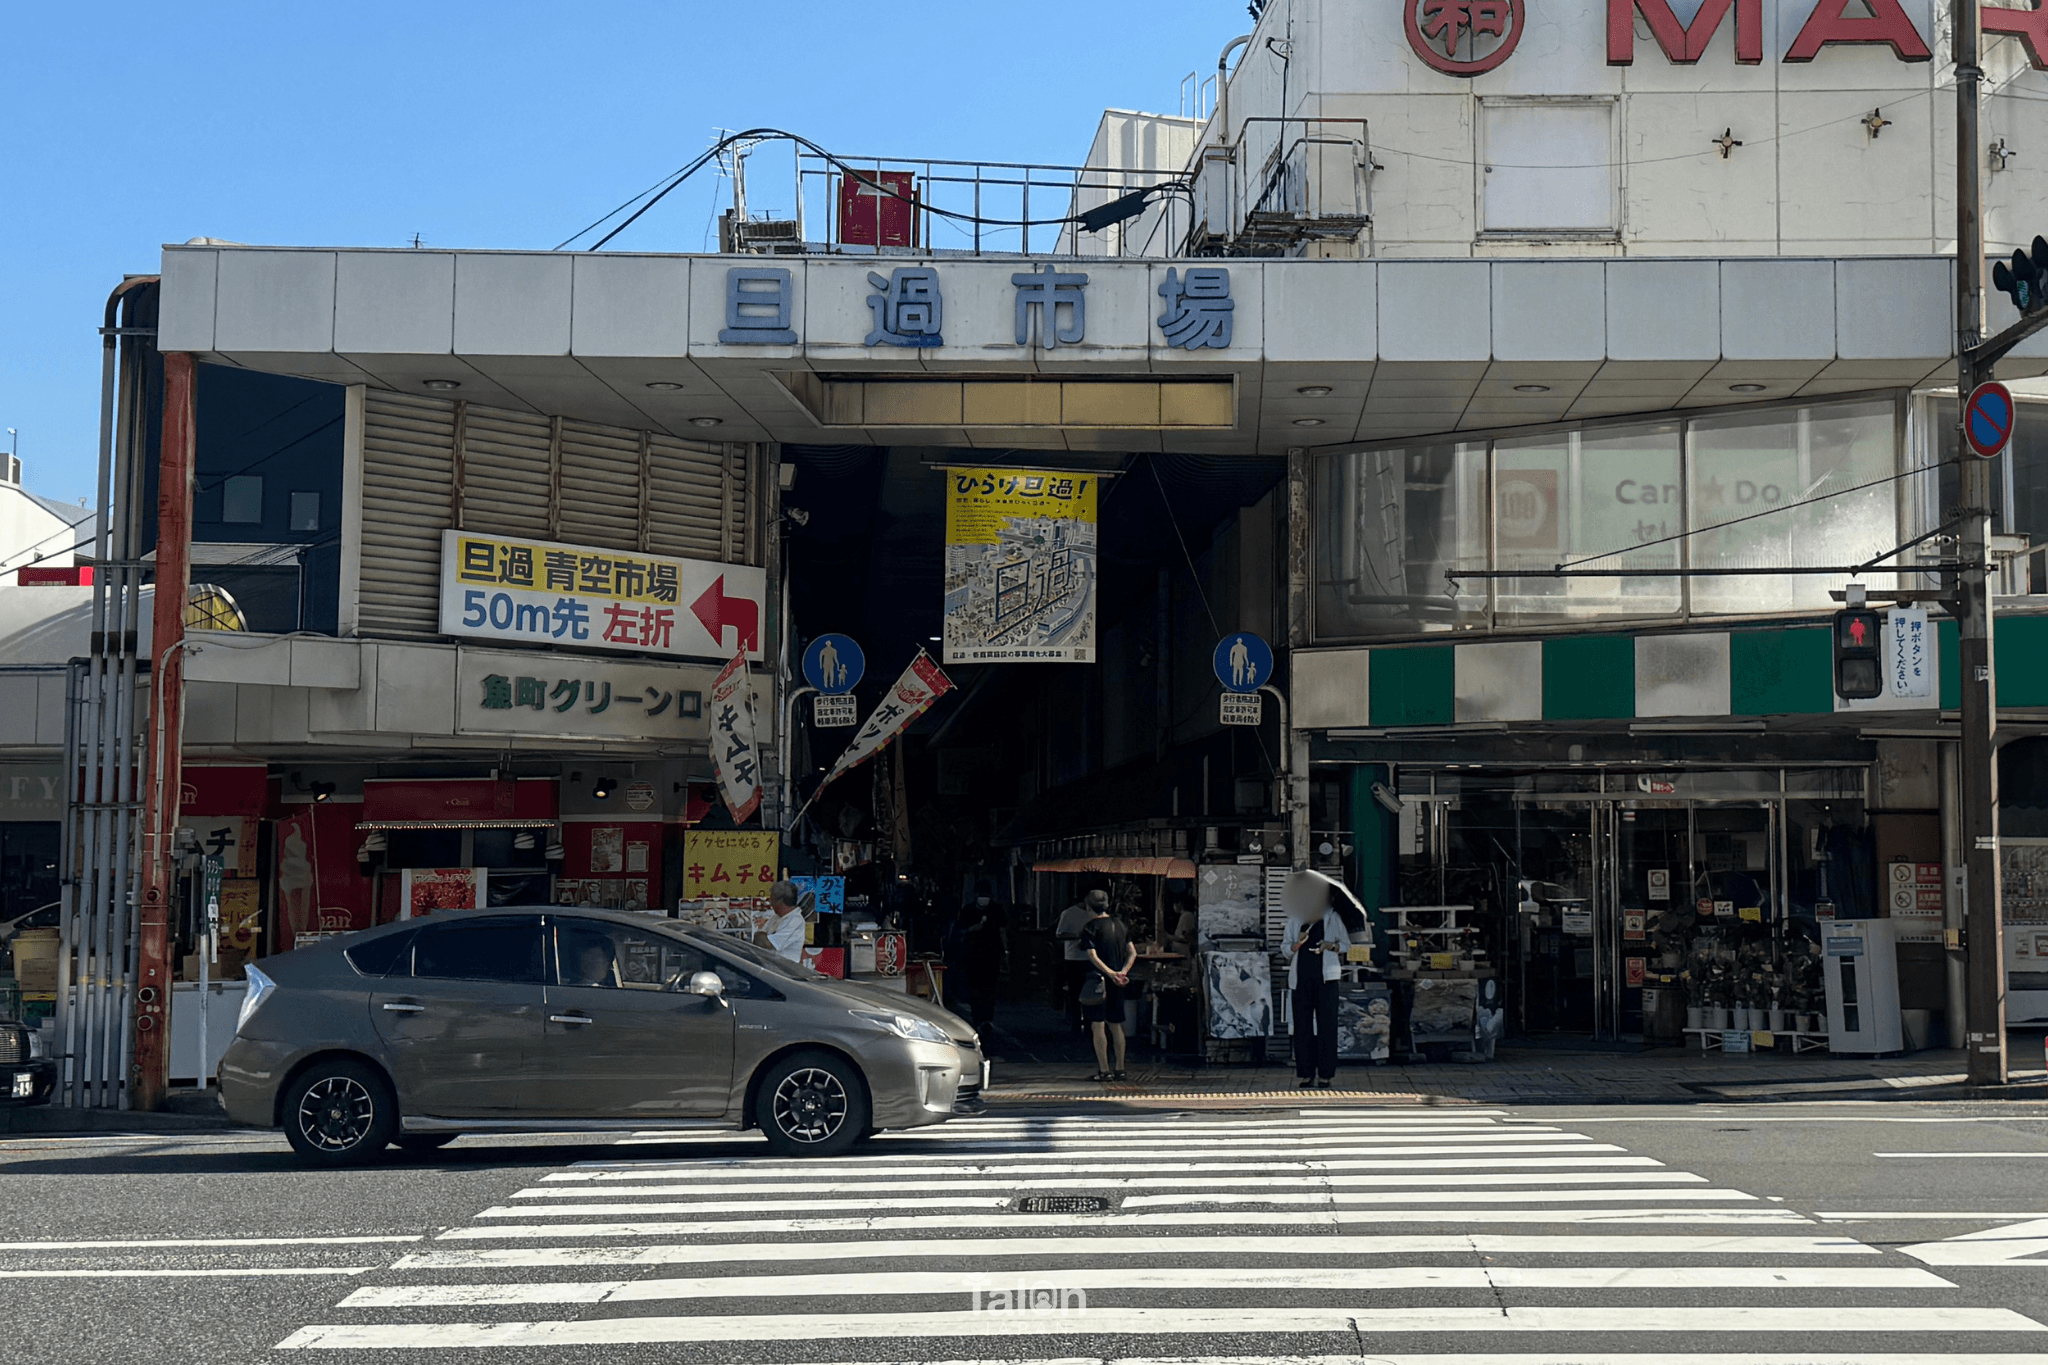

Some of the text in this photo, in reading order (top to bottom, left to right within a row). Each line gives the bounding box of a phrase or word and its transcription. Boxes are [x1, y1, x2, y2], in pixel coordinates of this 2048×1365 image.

[717, 264, 1236, 349] 旦過市場
[1734, 479, 1782, 504] Do
[460, 541, 679, 603] 旦過 青空市場
[461, 589, 676, 648] 50m先 左折
[1895, 617, 1908, 690] 押してください
[1910, 621, 1923, 677] 押ボタンを
[481, 673, 758, 721] 魚町グリーンロ
[718, 703, 757, 787] キムチ
[704, 836, 761, 849] クセになる
[688, 862, 775, 885] キムチ&
